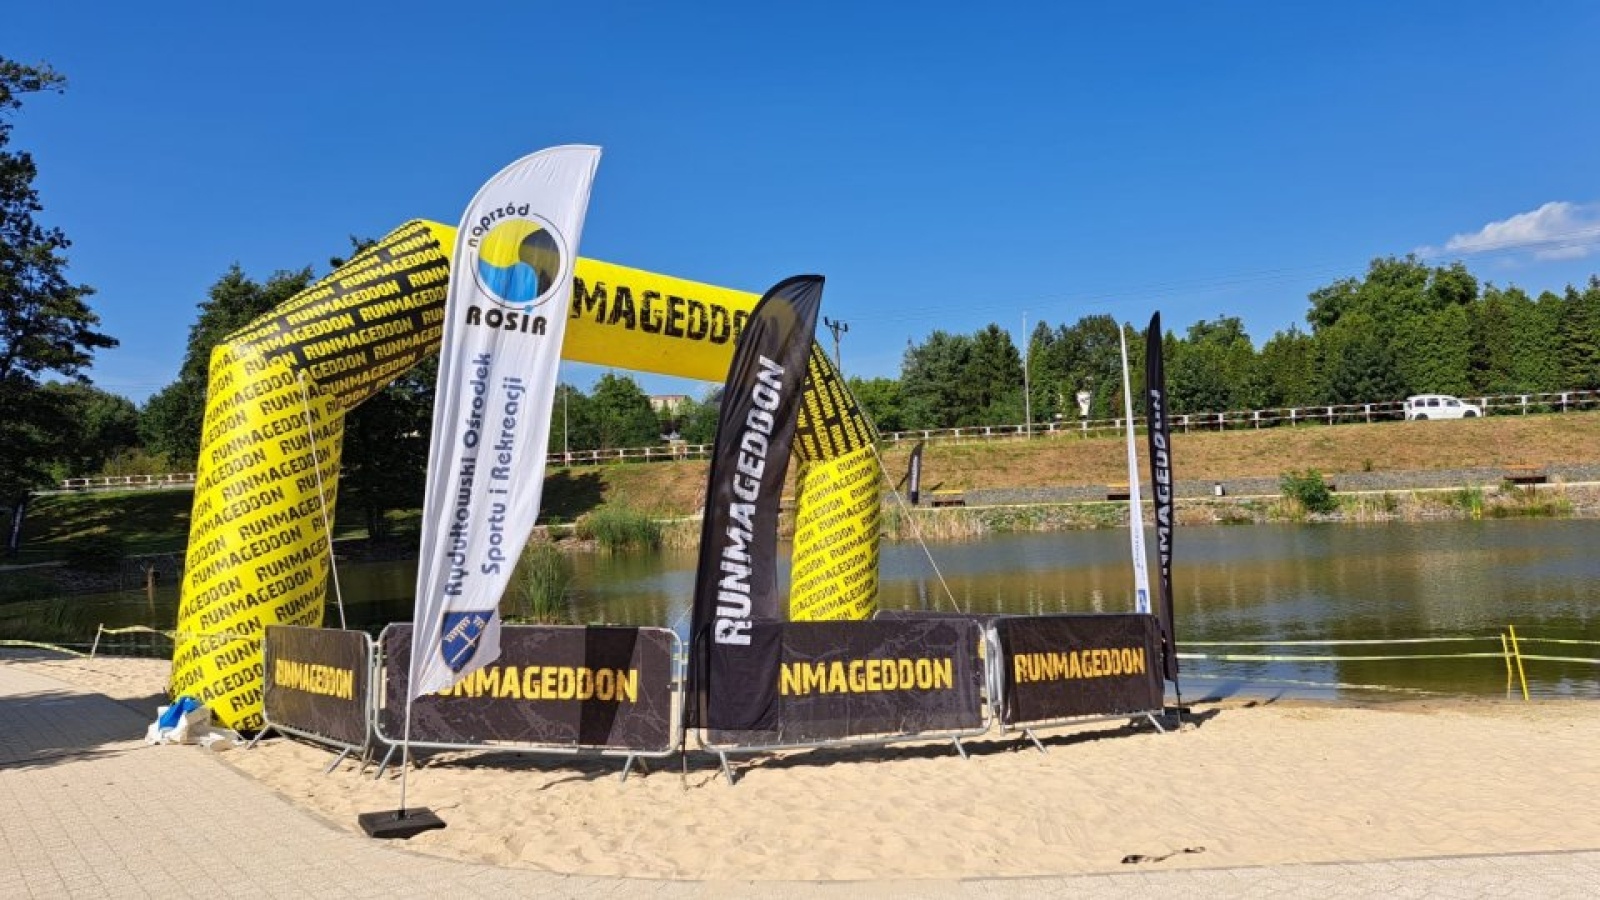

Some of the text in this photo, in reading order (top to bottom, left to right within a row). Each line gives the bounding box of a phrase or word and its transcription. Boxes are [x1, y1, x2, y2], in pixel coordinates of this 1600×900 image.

[467, 202, 531, 248] naprzód
[302, 316, 414, 361] RUNMAGEDDON
[465, 304, 548, 336] ROSIR
[462, 352, 492, 449] Ośrodek
[491, 376, 526, 481] Rekreacji
[210, 406, 321, 465] RUNMAGEDDON
[714, 354, 786, 646] RUNMAGEDDON
[481, 503, 506, 575] Sportu
[199, 565, 314, 631] RUNMAGEDDON
[1014, 647, 1146, 684] RUNMAGEDDON
